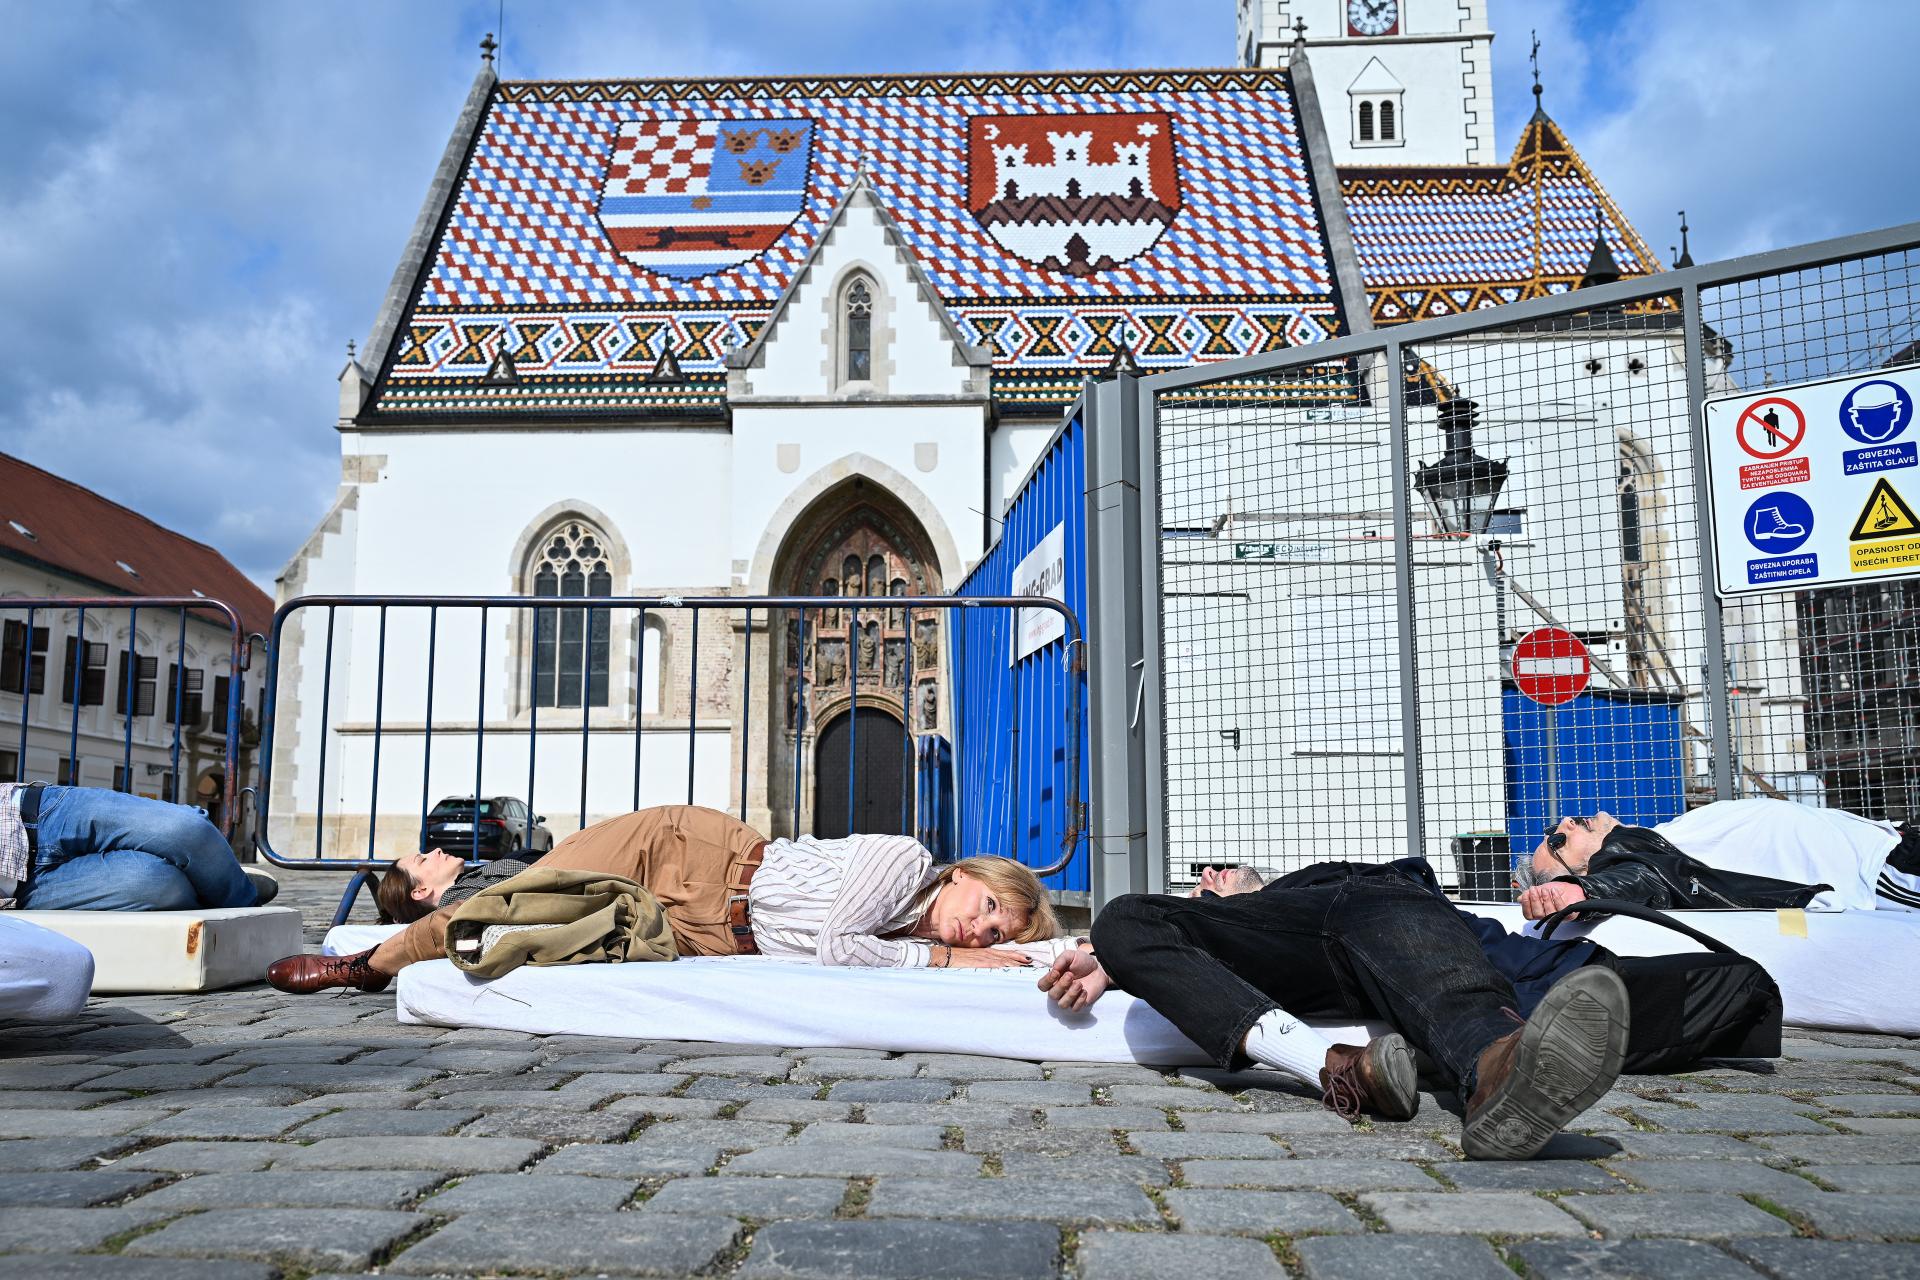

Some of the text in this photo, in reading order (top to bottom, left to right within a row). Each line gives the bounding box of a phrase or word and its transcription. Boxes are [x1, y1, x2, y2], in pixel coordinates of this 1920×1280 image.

[1858, 448, 1902, 459] OBVEZNA
[1846, 456, 1915, 471] ZAŠTITA GLAVE
[1856, 545, 1904, 555] OPASNOST
[1750, 558, 1814, 570] OBVEZNA UPORABA
[1754, 568, 1811, 579] ZAŠTITNIH CIPELA
